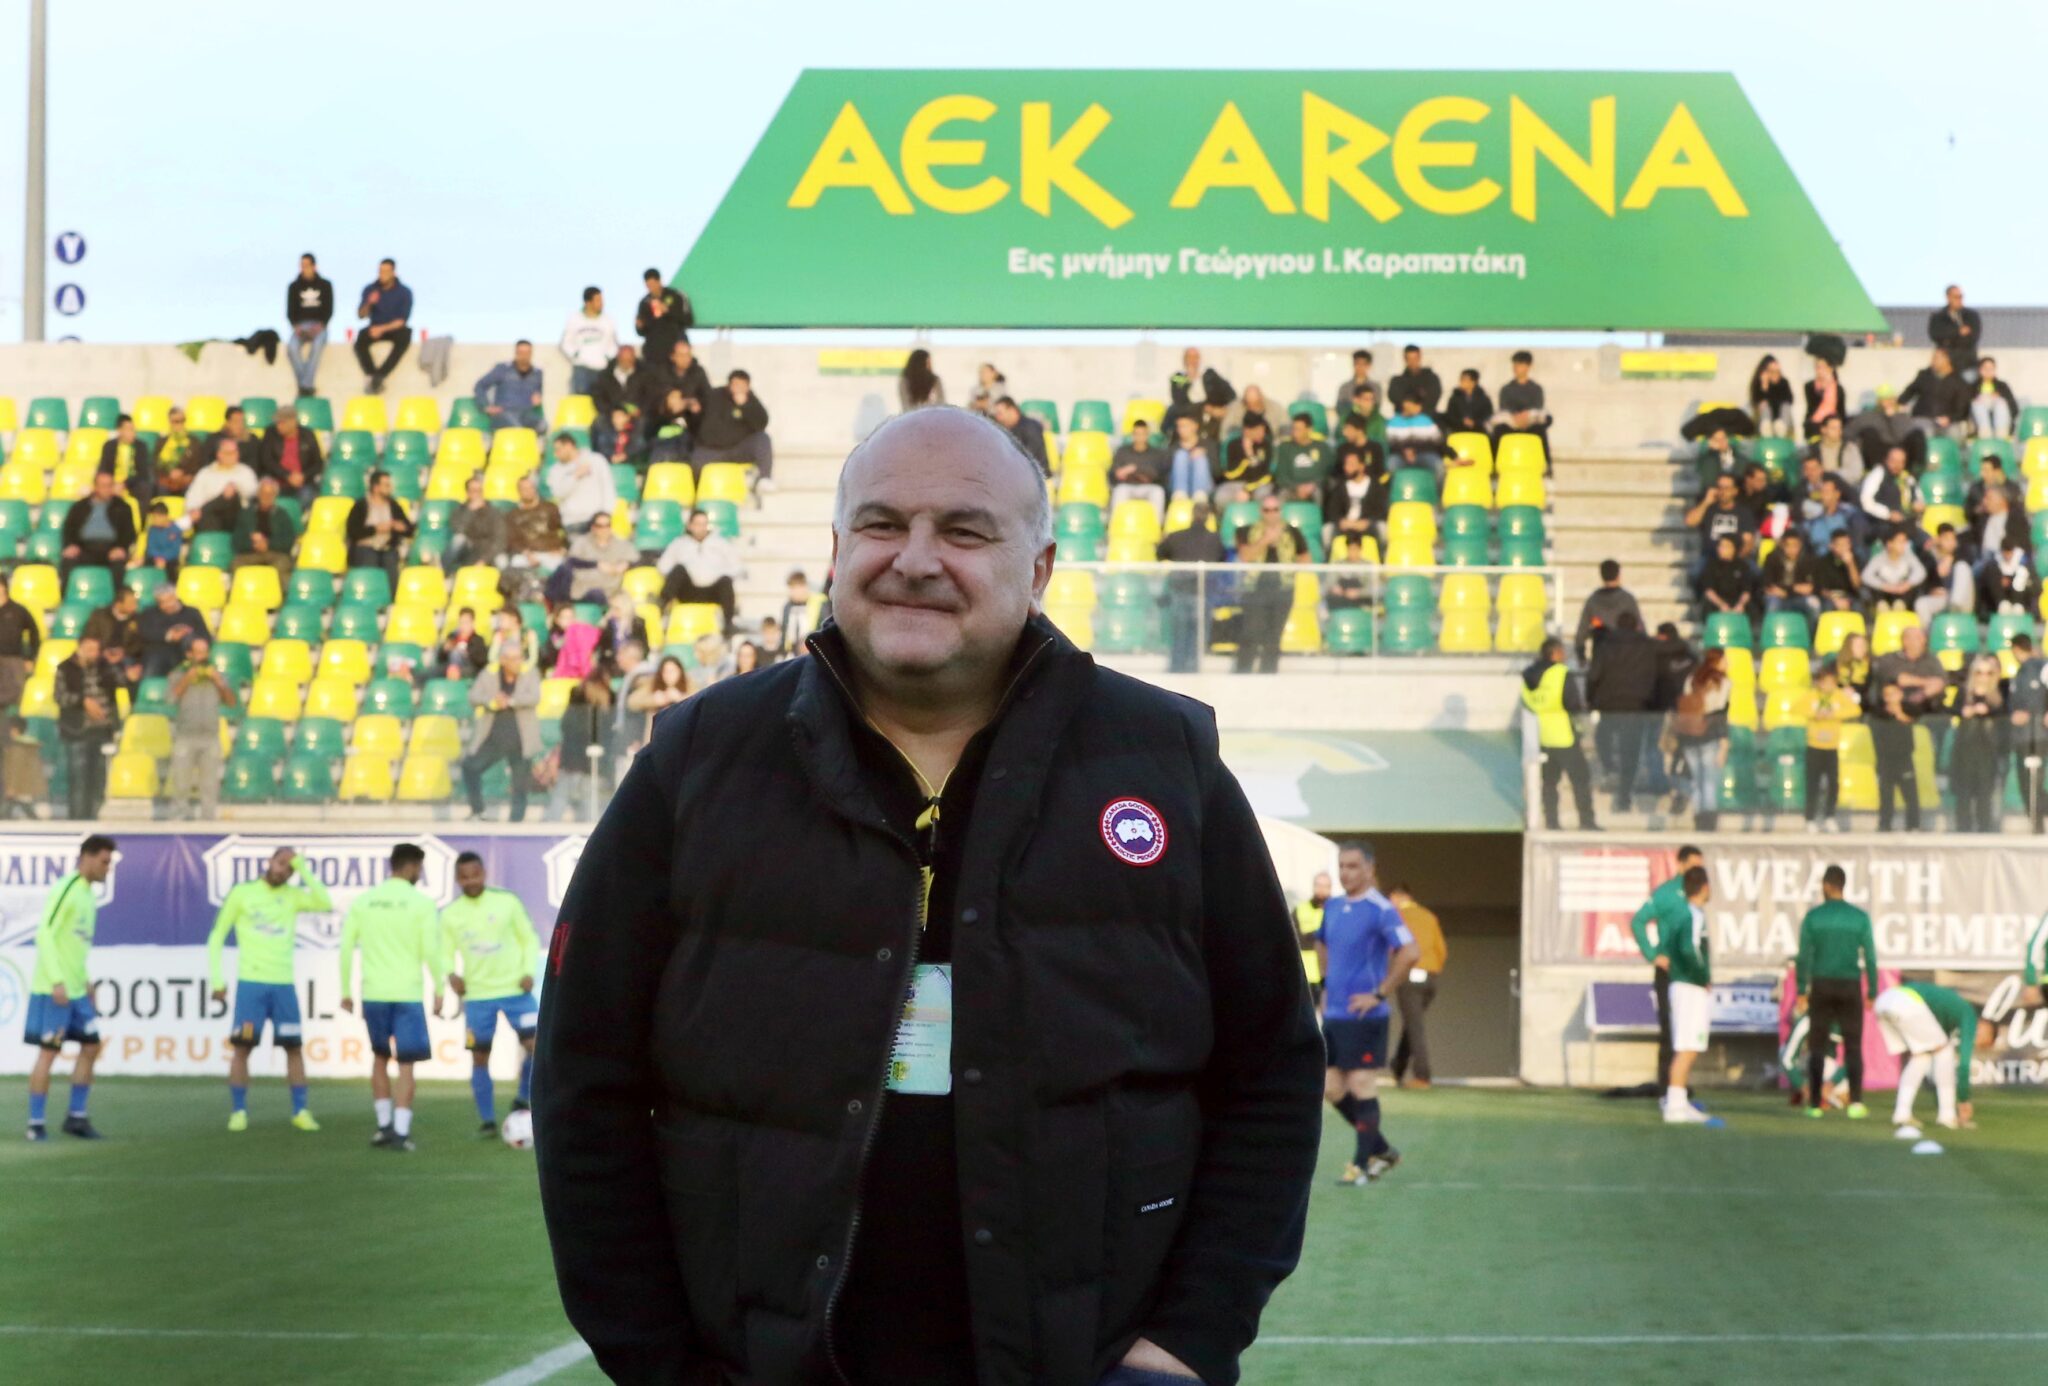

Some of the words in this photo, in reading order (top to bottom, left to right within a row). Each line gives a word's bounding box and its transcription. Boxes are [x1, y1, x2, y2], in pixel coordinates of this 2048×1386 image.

[788, 94, 1134, 229] AEK
[1170, 90, 1749, 223] ARENA
[1008, 247, 1055, 279] Εις
[1062, 245, 1171, 279] μνήμην
[1179, 245, 1316, 279] Γεώργιου
